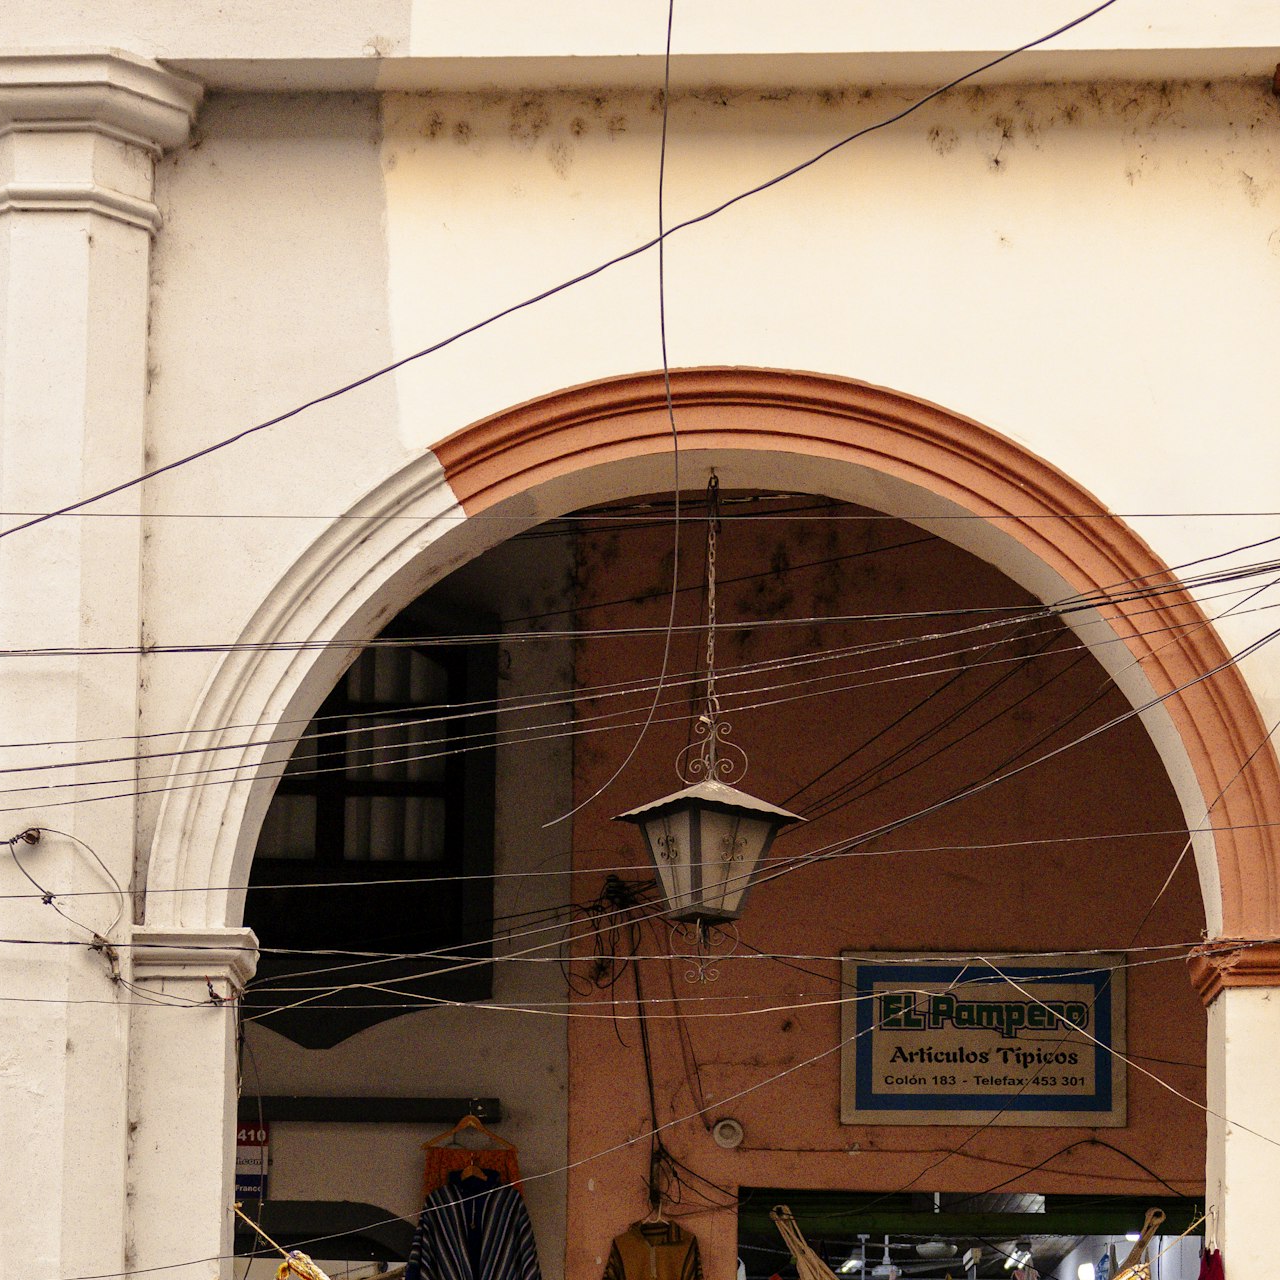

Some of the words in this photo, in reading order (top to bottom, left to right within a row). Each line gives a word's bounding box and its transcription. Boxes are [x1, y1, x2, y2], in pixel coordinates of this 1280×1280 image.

[928, 993, 1089, 1039] Pampero
[889, 1046, 989, 1064] Artículos
[996, 1046, 1078, 1069] Típicos
[884, 1075, 927, 1086] Colón
[932, 1075, 956, 1086] 183
[1032, 1076, 1057, 1087] 453
[1061, 1076, 1085, 1087] 301
